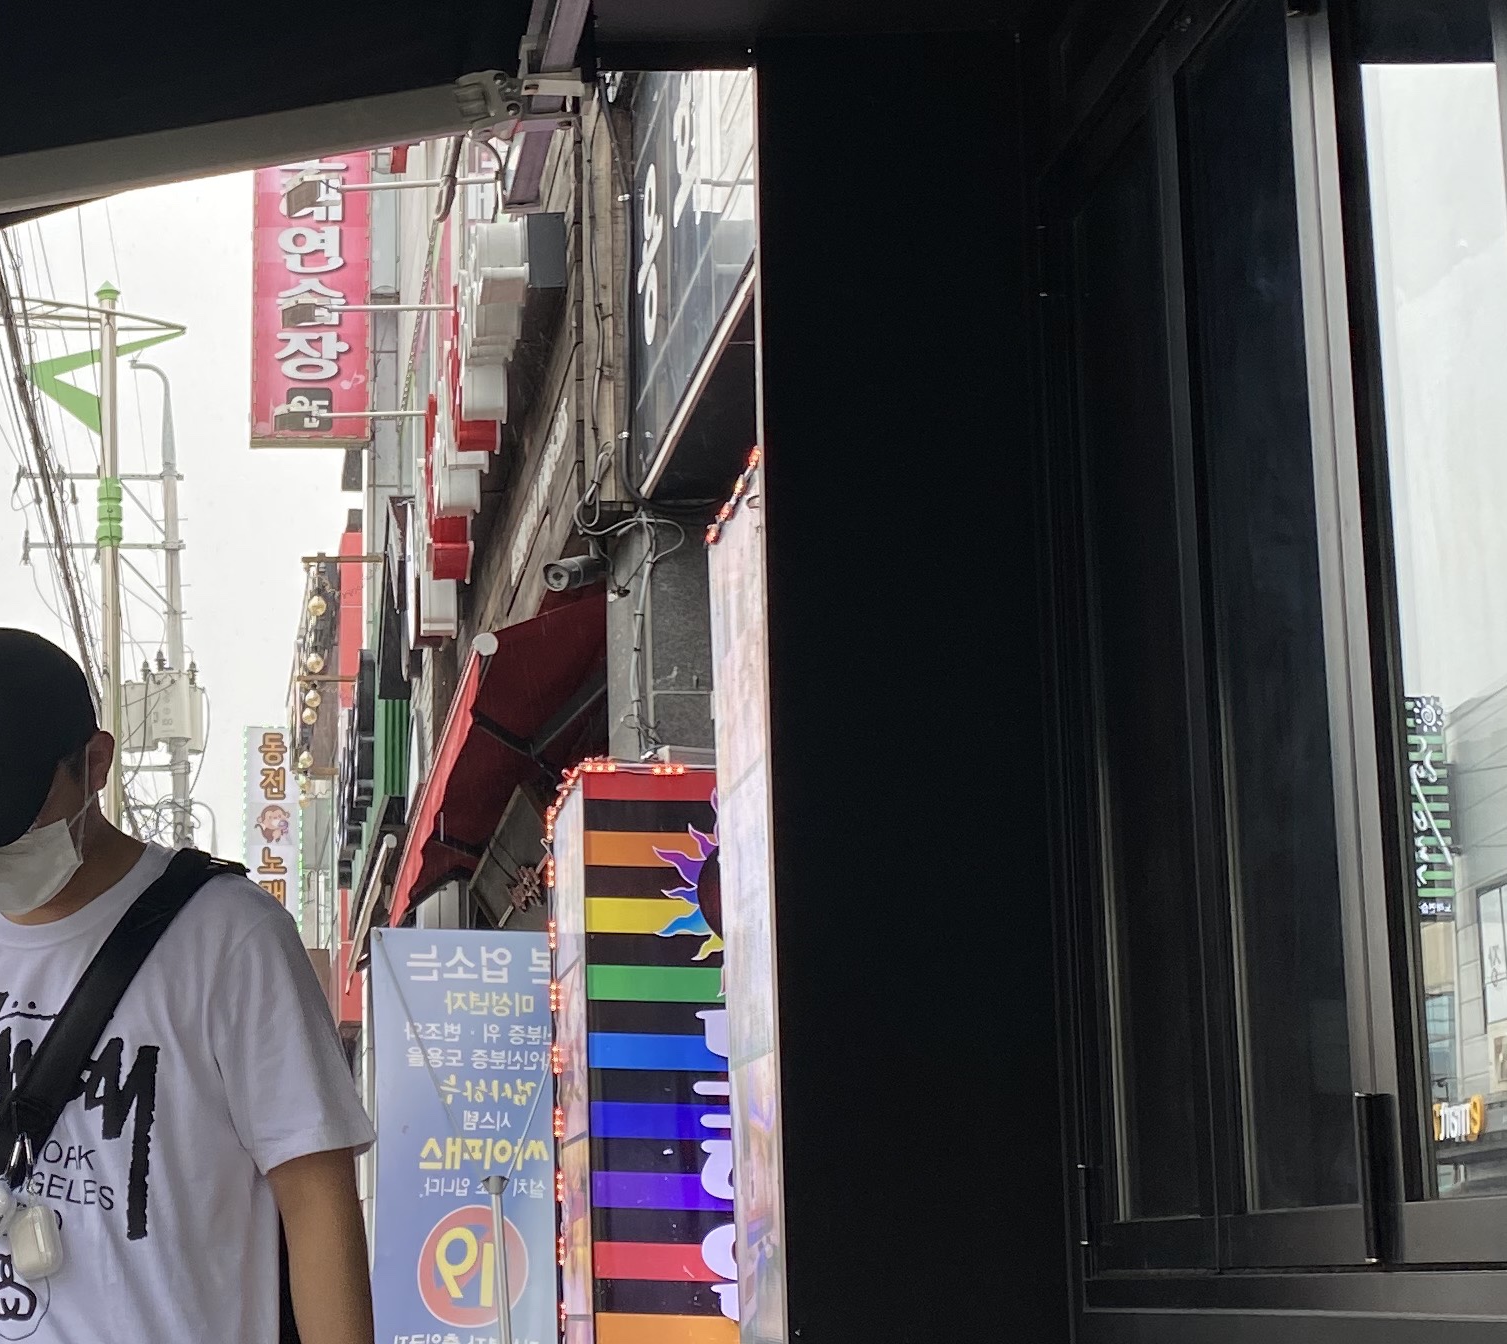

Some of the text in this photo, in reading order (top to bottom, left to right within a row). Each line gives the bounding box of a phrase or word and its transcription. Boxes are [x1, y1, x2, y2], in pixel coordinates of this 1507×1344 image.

[275, 159, 349, 380] 래연습장
[258, 732, 288, 801] 동전
[19, 1171, 114, 1211] GELES
